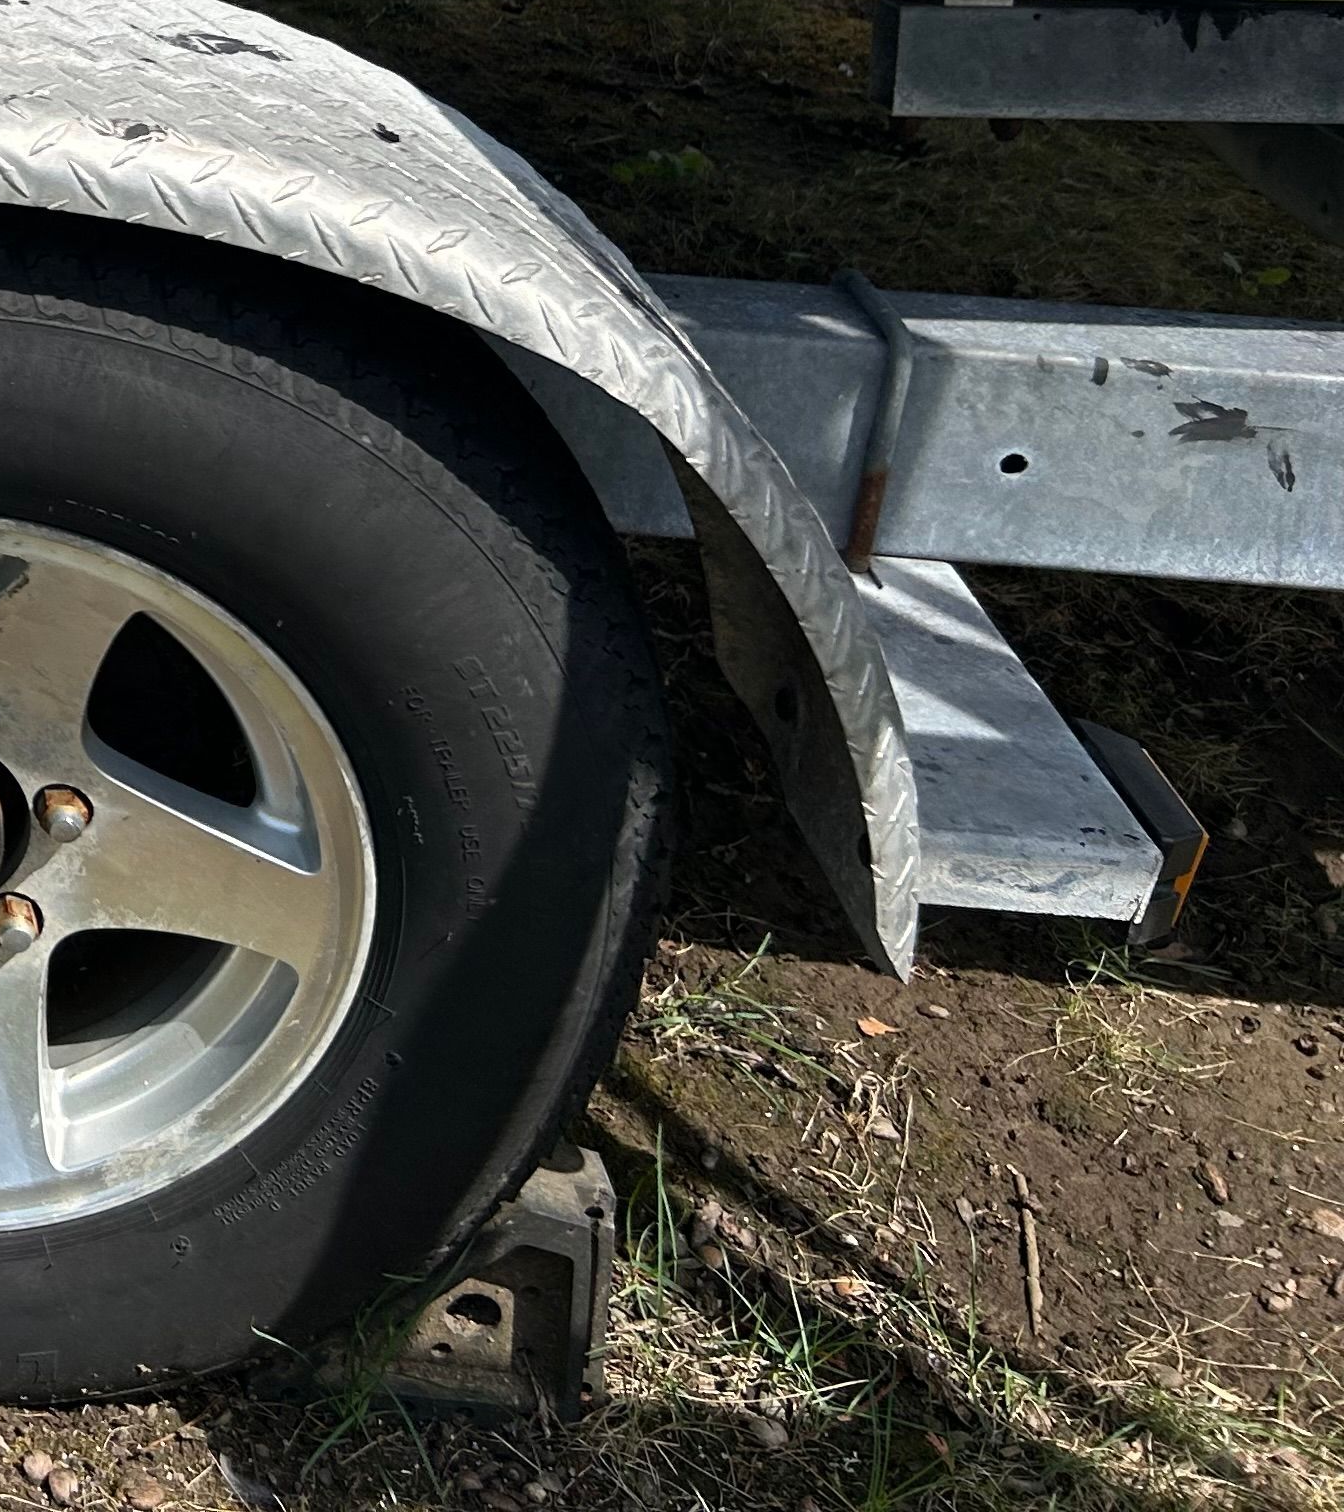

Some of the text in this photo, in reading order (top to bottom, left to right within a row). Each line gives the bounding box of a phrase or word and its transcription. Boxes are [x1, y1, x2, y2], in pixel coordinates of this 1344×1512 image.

[398, 686, 433, 726] FOR
[430, 738, 473, 811] TRAILER
[459, 824, 481, 864] USE
